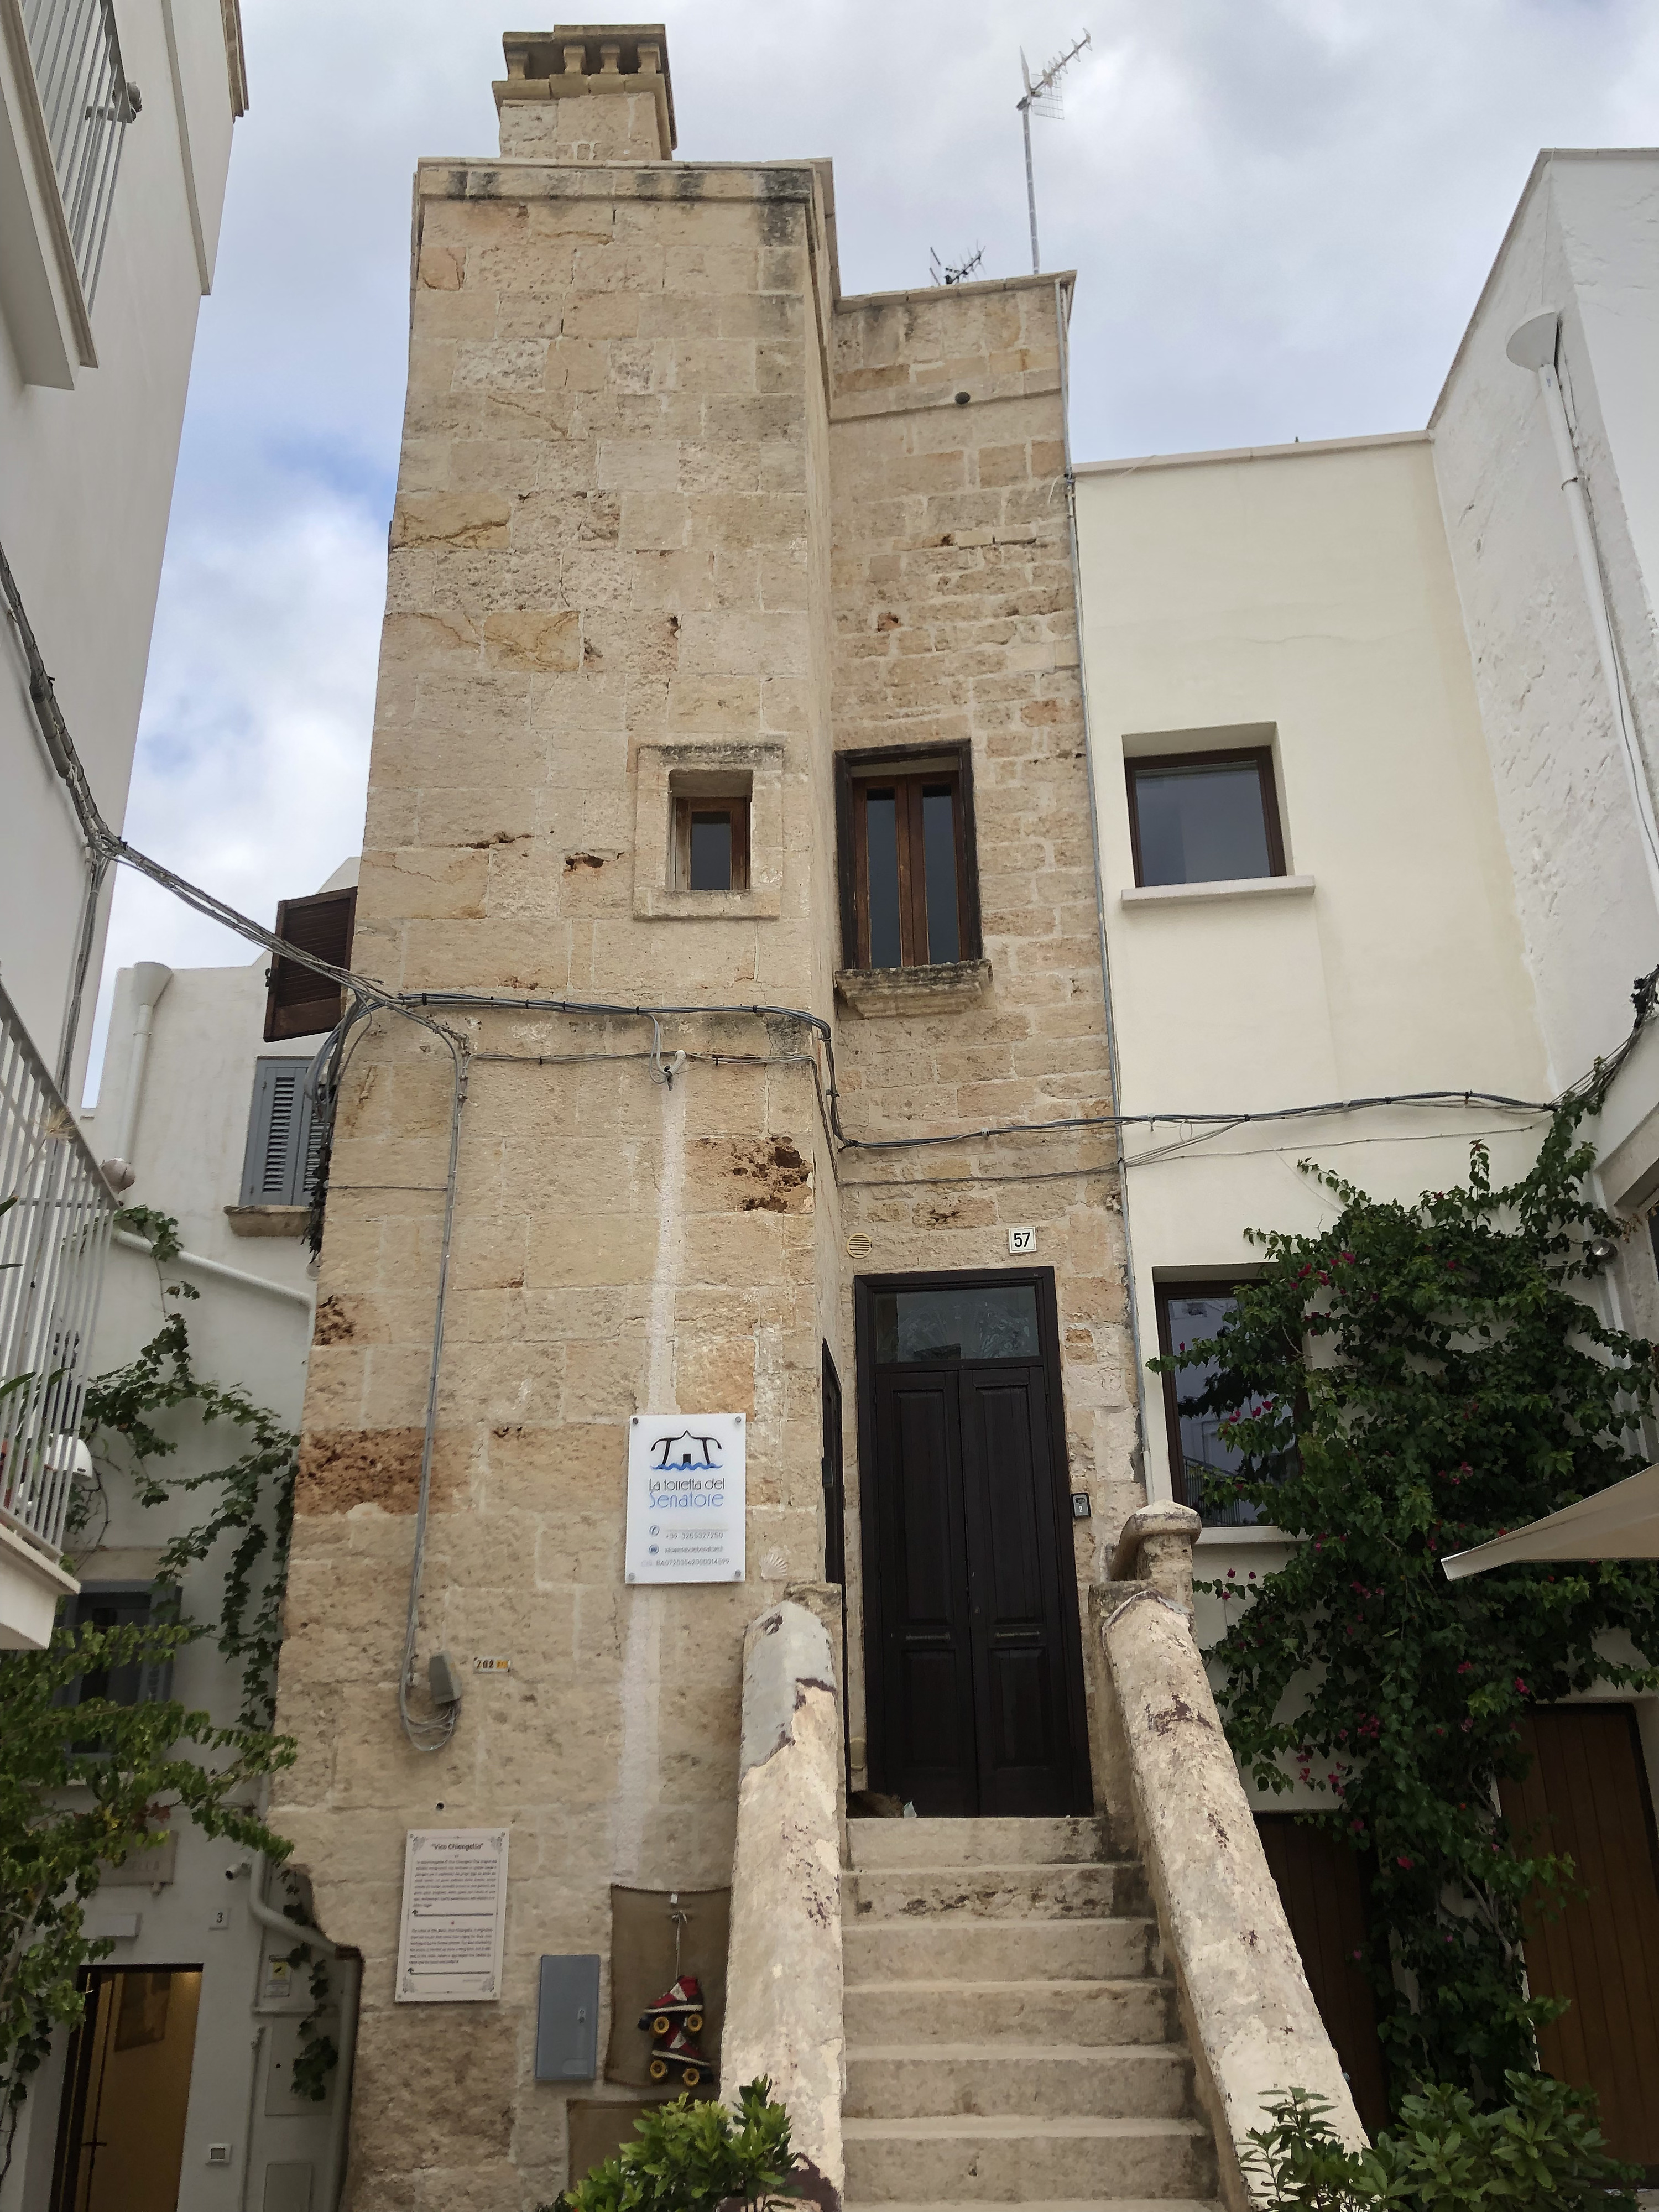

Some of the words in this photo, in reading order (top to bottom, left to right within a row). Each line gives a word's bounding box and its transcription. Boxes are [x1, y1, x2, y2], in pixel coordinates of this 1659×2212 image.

[1014, 1232, 1030, 1247] 57
[649, 1478, 660, 1491] La
[664, 1478, 701, 1491] torretta
[705, 1478, 724, 1490] del
[649, 1490, 724, 1509] Senatore
[216, 1912, 223, 1923] 3
